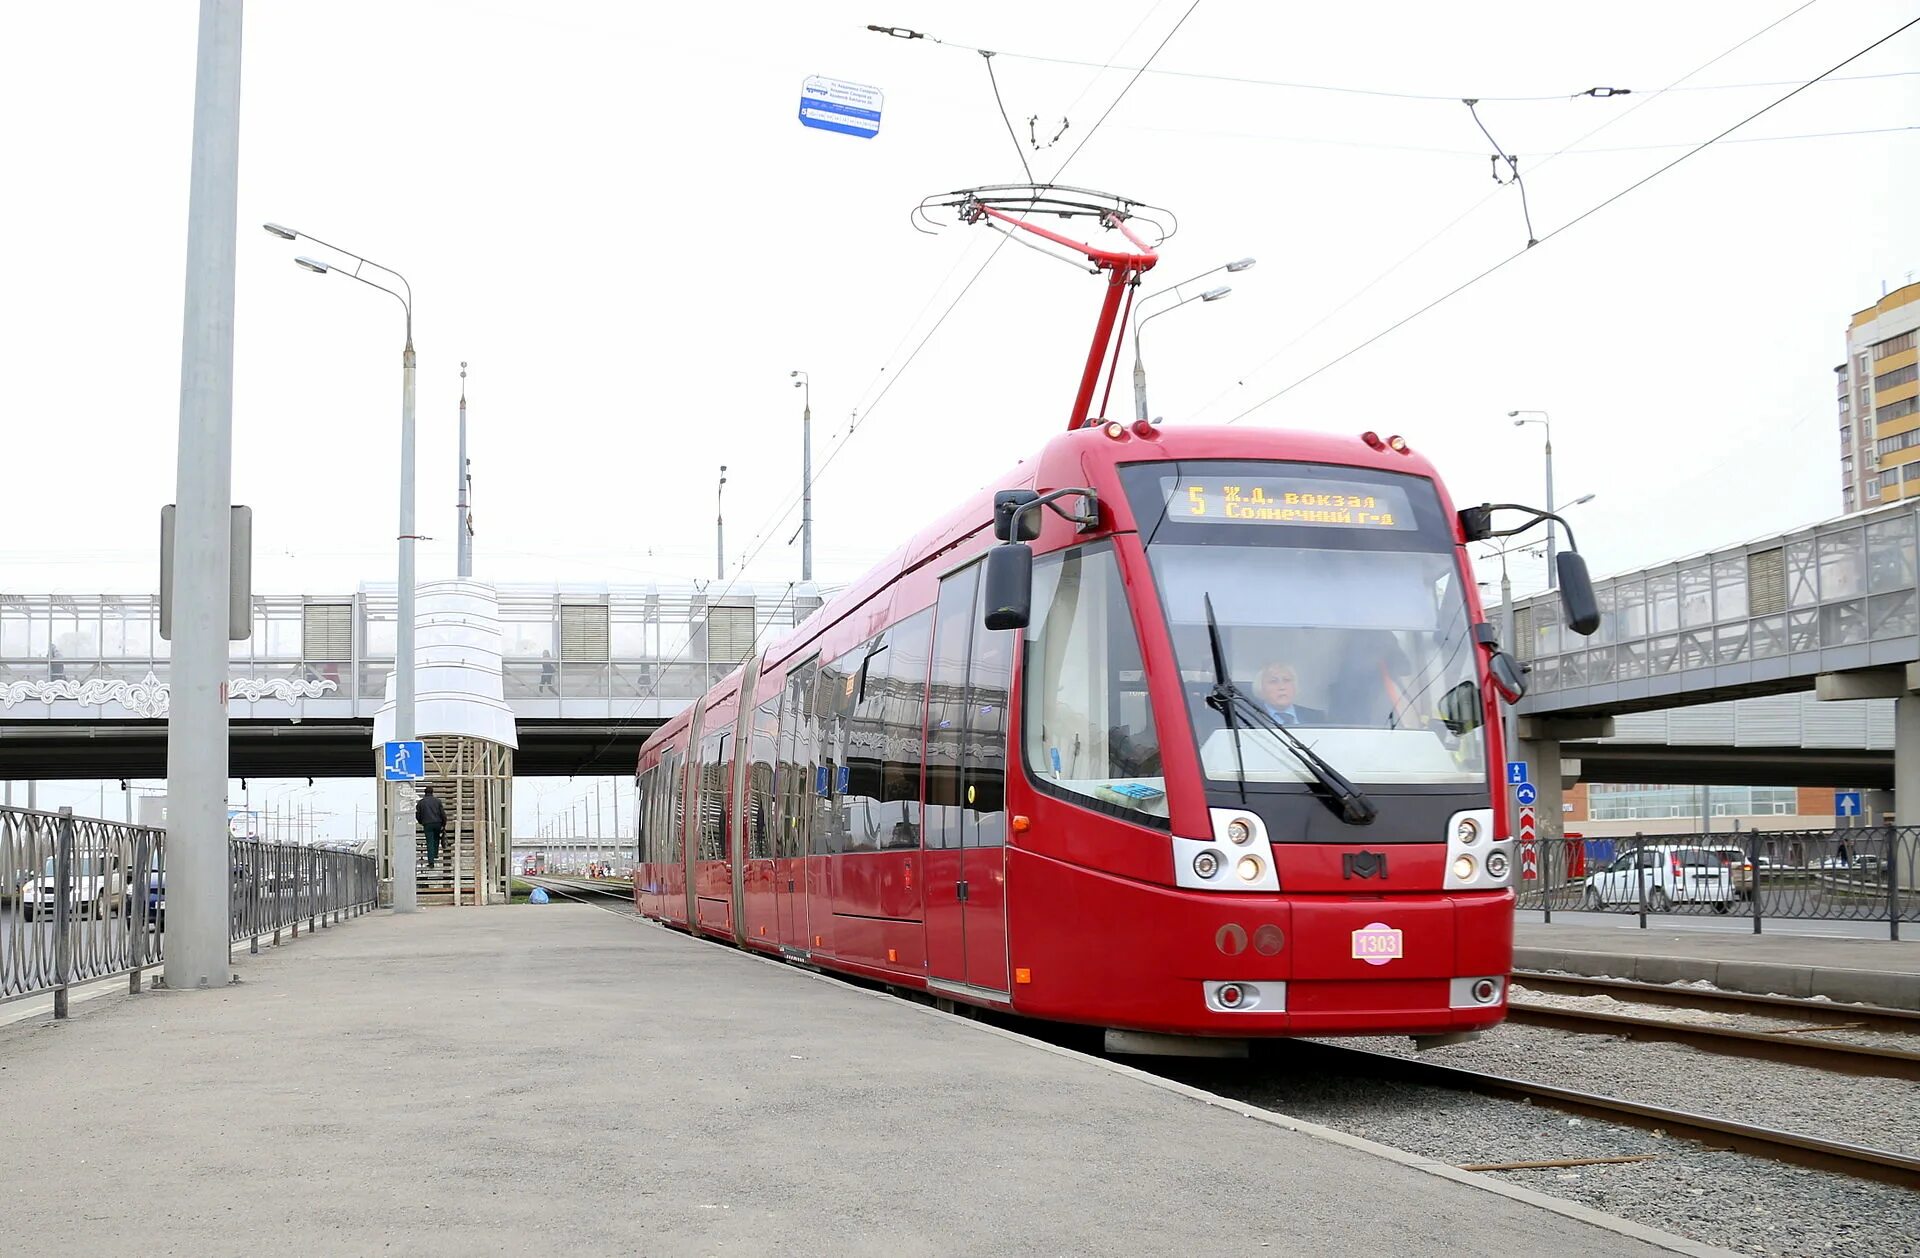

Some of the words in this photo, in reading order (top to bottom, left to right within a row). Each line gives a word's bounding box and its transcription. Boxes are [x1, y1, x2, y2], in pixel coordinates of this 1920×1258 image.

[1189, 486, 1205, 515] 5
[1284, 492, 1376, 508] вокзал
[1226, 503, 1352, 523] Солнечный
[1360, 935, 1396, 953] 1303
